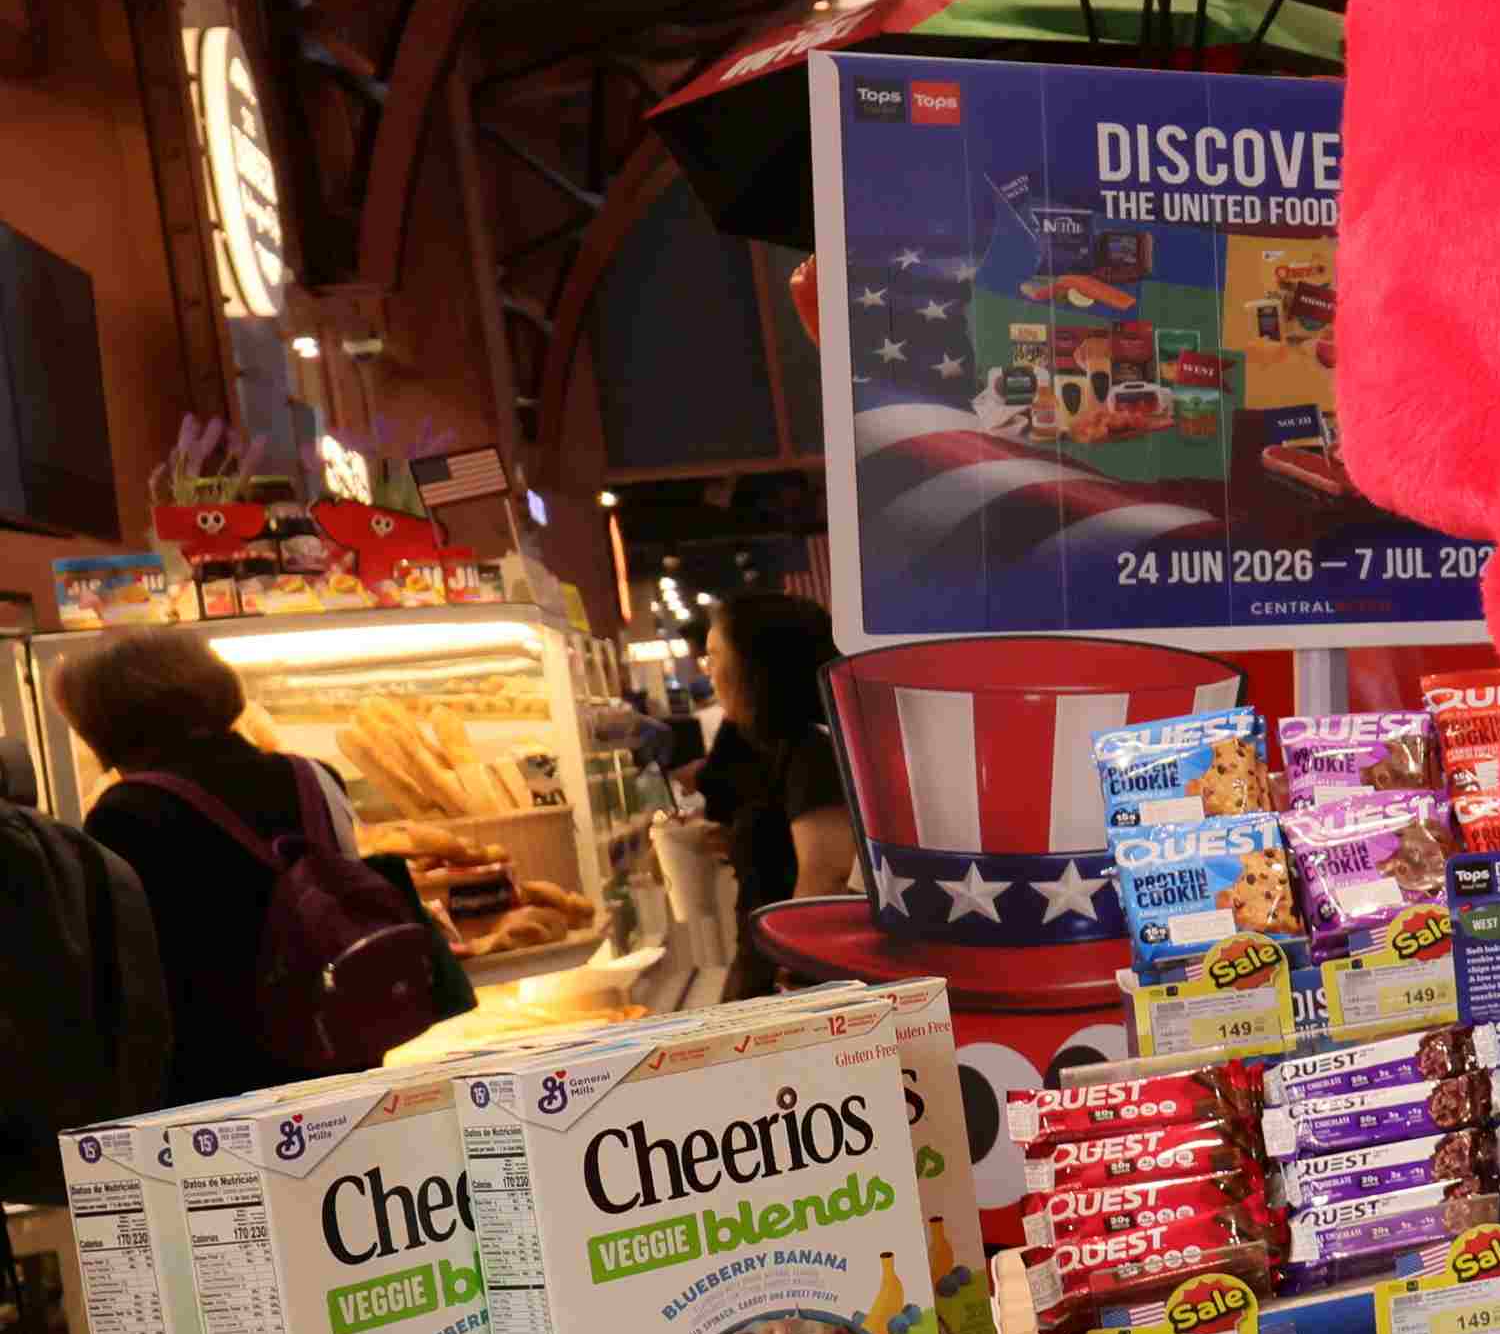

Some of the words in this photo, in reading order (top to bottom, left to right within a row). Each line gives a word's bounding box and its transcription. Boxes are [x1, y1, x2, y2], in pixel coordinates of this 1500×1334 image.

[856, 87, 902, 105] Tops
[914, 94, 958, 109] Tops
[1101, 190, 1155, 221] THE
[1163, 193, 1261, 224] UNITED
[1269, 196, 1338, 226] FOOD
[1117, 552, 1159, 586] 24
[1168, 550, 1223, 584] JUN
[1233, 548, 1313, 583] 2026
[1355, 548, 1373, 580] 7
[1382, 547, 1432, 580] JUL
[1133, 868, 1208, 892] PROTEIN
[1456, 868, 1490, 881] Tops
[1136, 885, 1210, 909] COOKIE
[1393, 917, 1451, 953] Sale
[1210, 943, 1281, 987] Sale
[1403, 987, 1435, 1005] 149
[827, 1015, 847, 1037] 12
[1217, 1021, 1252, 1039] 149
[834, 1046, 872, 1066] Gluten
[873, 1042, 899, 1058] Free
[568, 1071, 610, 1087] General
[570, 1085, 596, 1097] Mills
[583, 1086, 877, 1215] Cheerios
[597, 1224, 689, 1273] VEGGIE
[702, 1172, 895, 1255] blends
[661, 1253, 768, 1323] BLUEBERRY
[774, 1250, 849, 1273] BANANA
[337, 1274, 428, 1325] VEGGIE
[1456, 1310, 1491, 1330] 149
